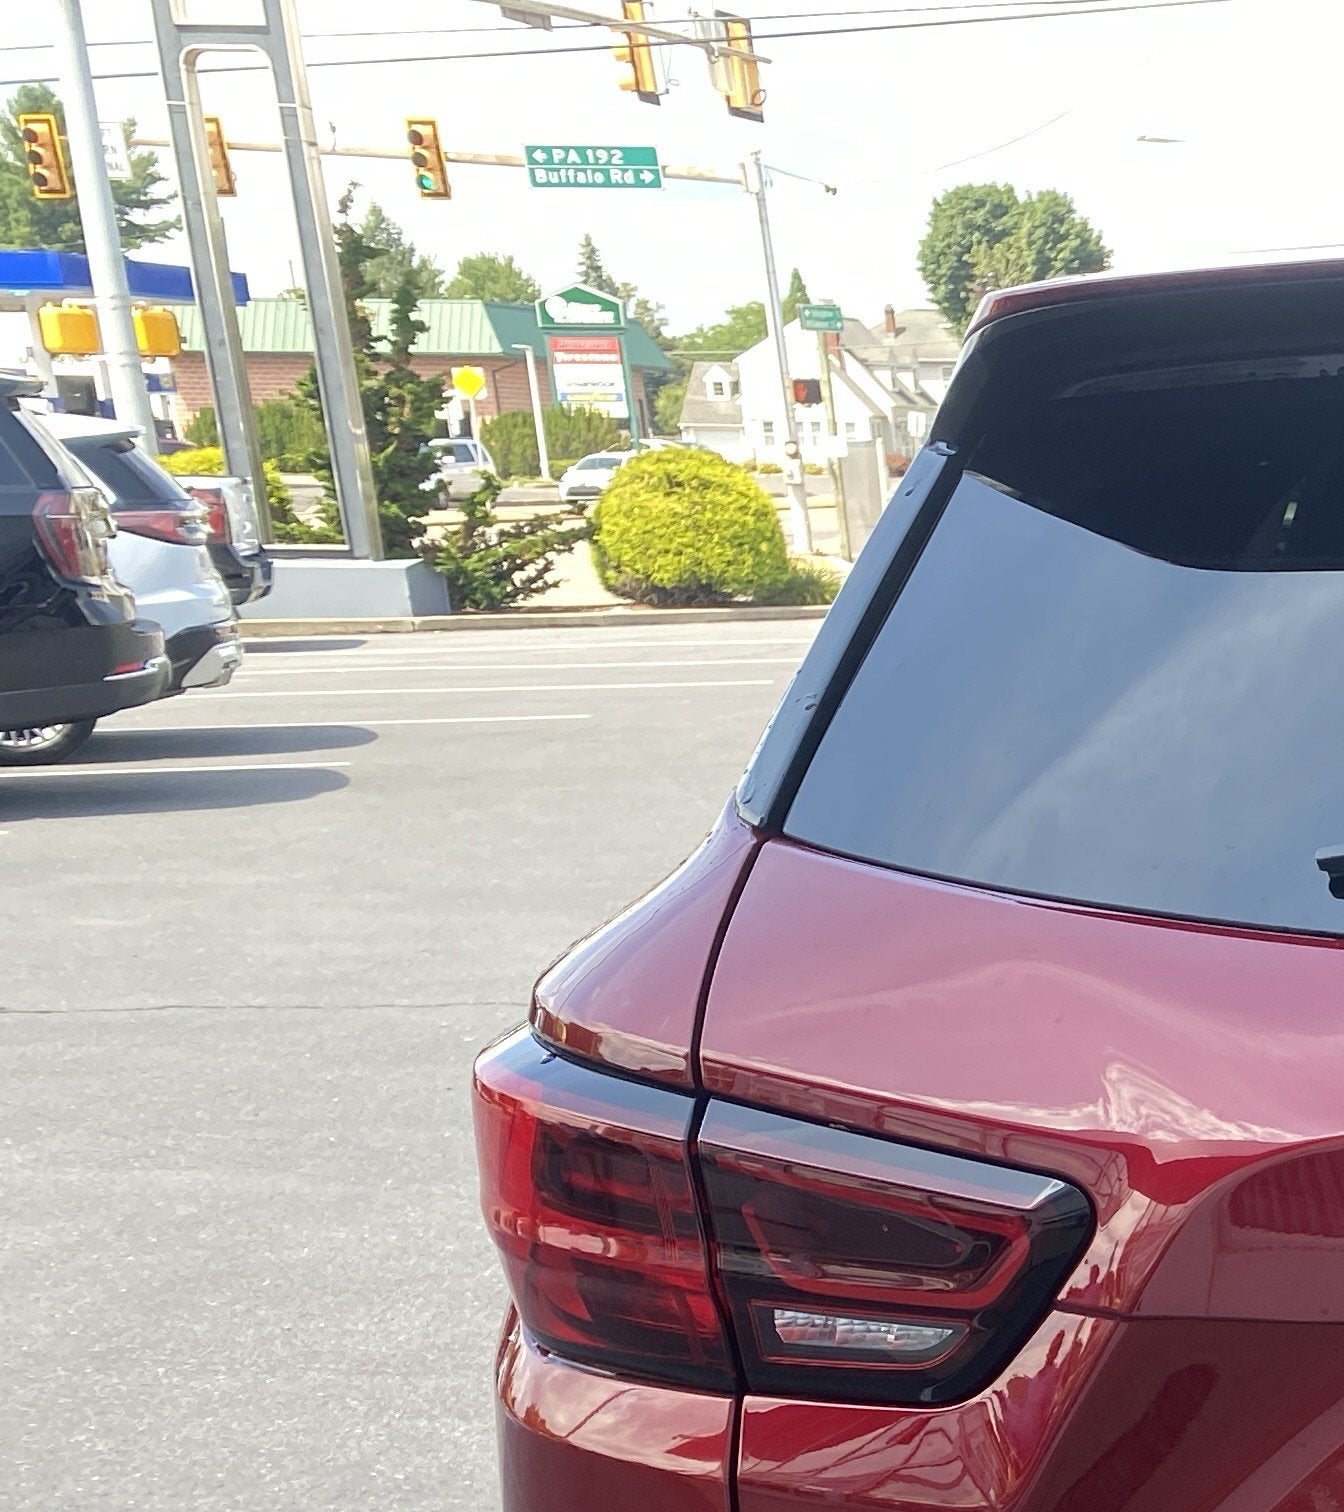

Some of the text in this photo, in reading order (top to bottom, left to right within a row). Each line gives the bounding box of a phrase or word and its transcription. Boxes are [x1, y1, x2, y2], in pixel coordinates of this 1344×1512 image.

[552, 149, 624, 165] PA 192
[534, 168, 635, 184] Buffalo Rd
